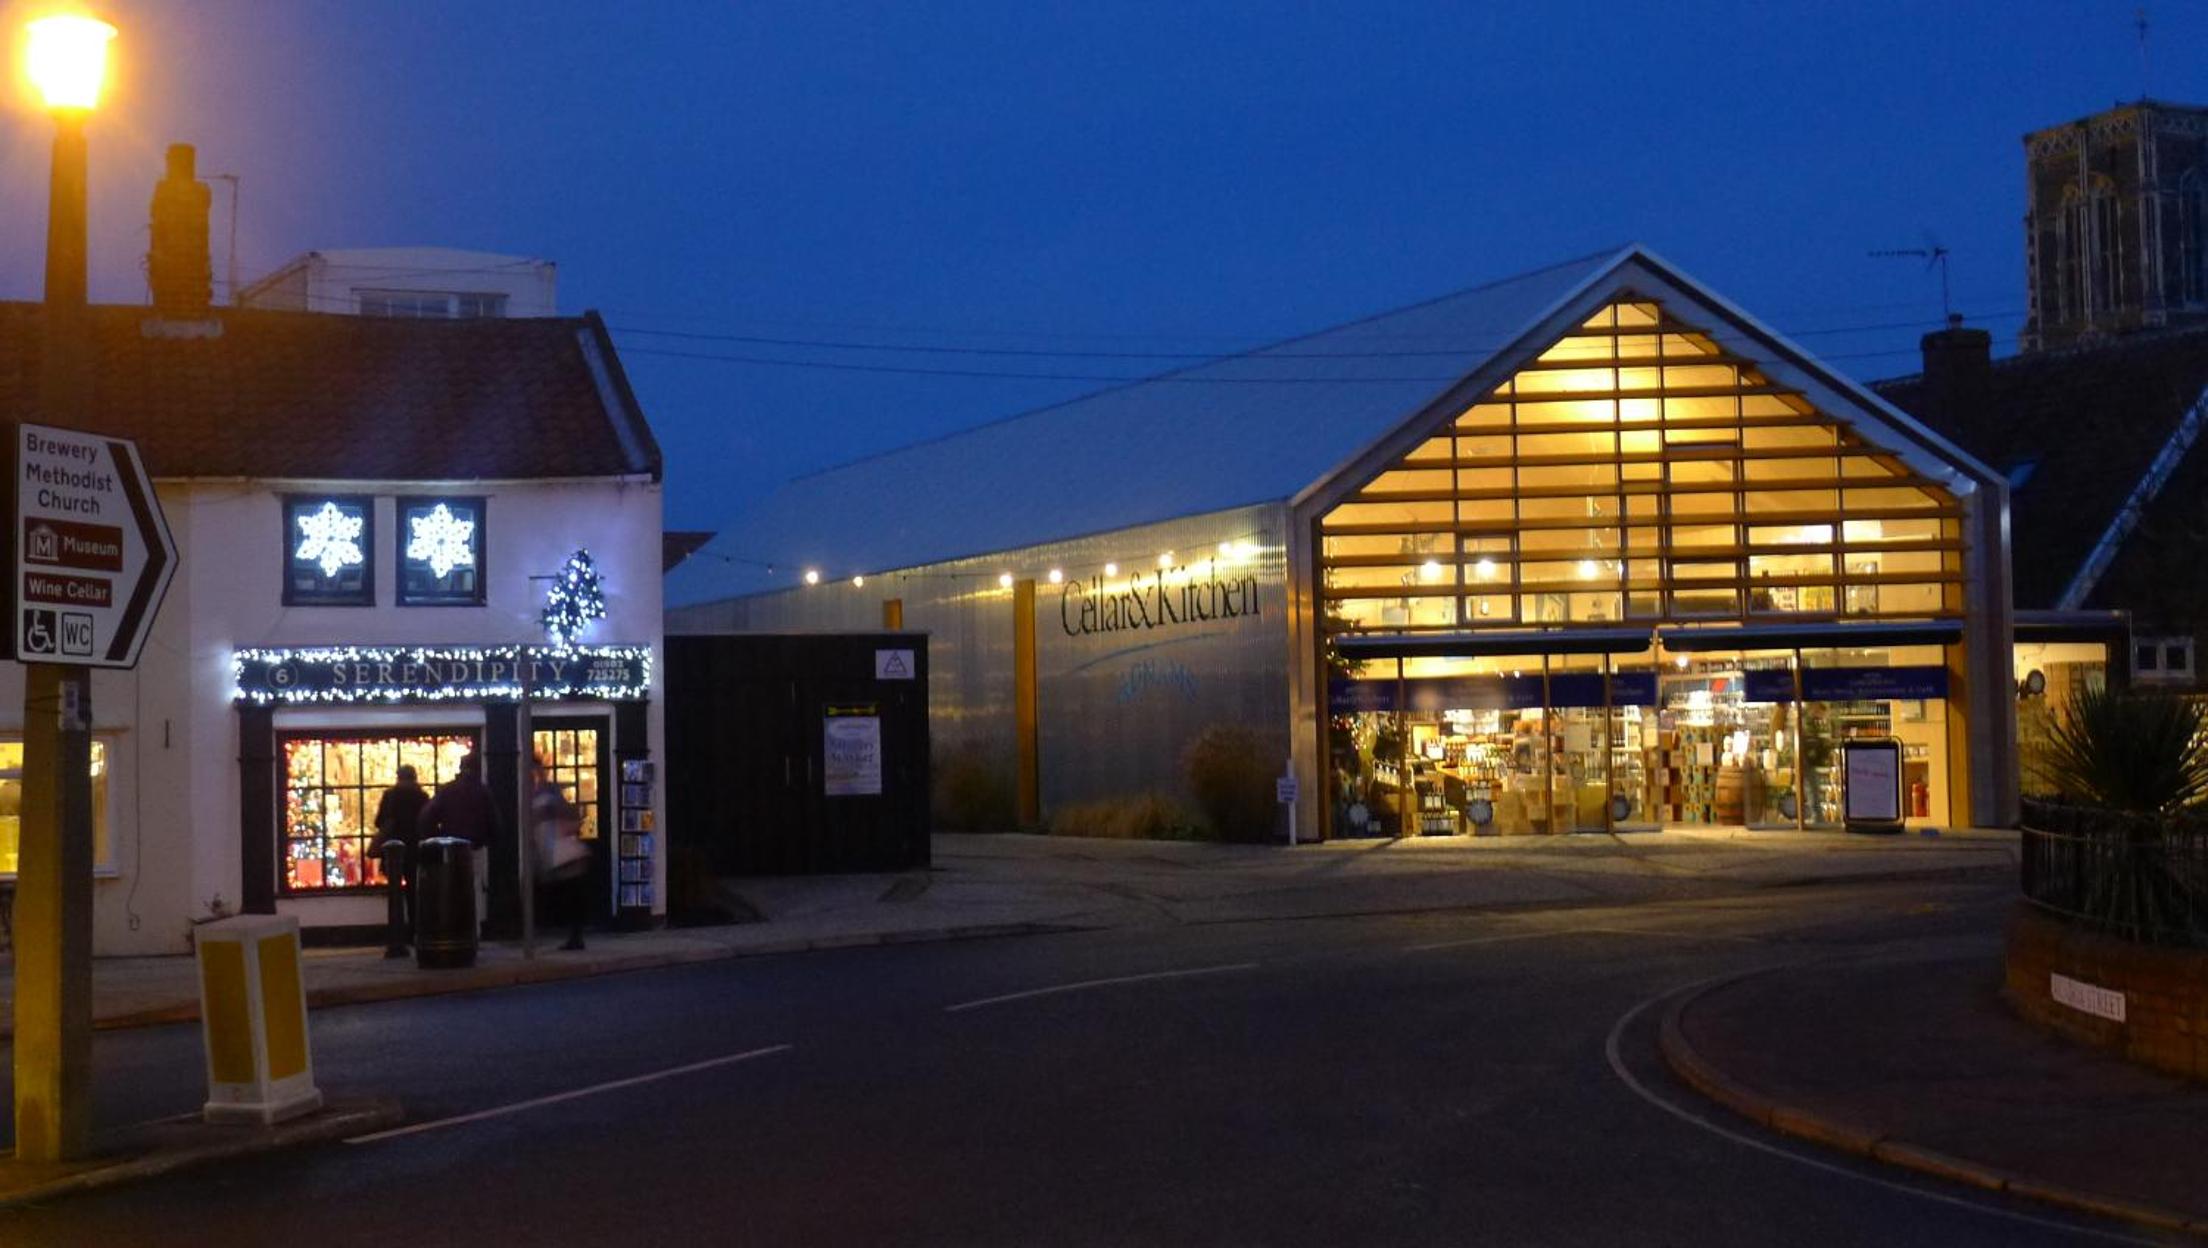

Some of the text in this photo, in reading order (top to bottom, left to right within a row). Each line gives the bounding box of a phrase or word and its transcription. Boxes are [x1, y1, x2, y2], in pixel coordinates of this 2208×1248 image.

[27, 432, 97, 464] Brewery
[26, 462, 112, 492] Methodist
[38, 489, 100, 515] Church
[63, 535, 118, 557] Museum
[29, 576, 108, 601] Wine Cellar
[65, 622, 90, 645] WC
[276, 668, 288, 683] 6
[333, 661, 566, 684] SERENDIPITY
